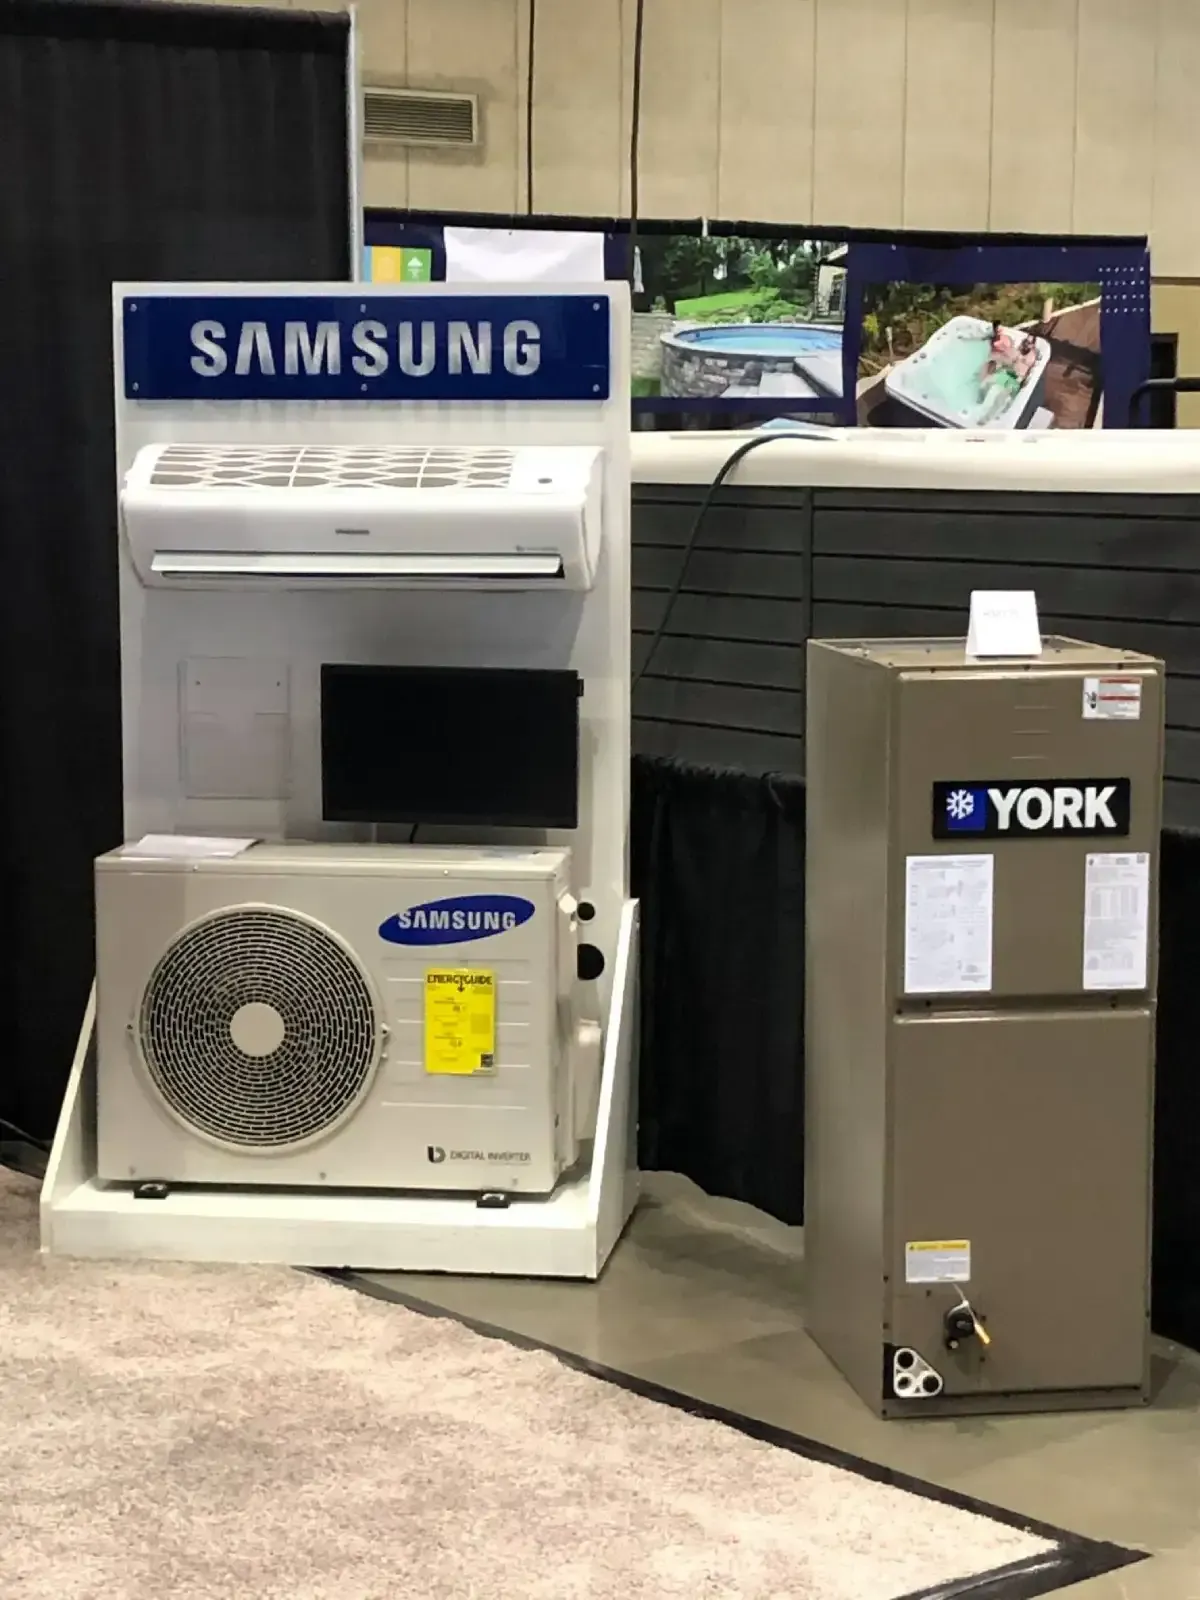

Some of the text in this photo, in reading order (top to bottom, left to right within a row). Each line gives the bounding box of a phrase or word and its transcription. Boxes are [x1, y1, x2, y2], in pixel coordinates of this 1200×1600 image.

[190, 320, 541, 377] SAMSUNG
[986, 786, 1118, 830] YORK
[397, 909, 517, 930] SAMSUNG
[449, 1150, 532, 1162] DIGITAL INVERTER
